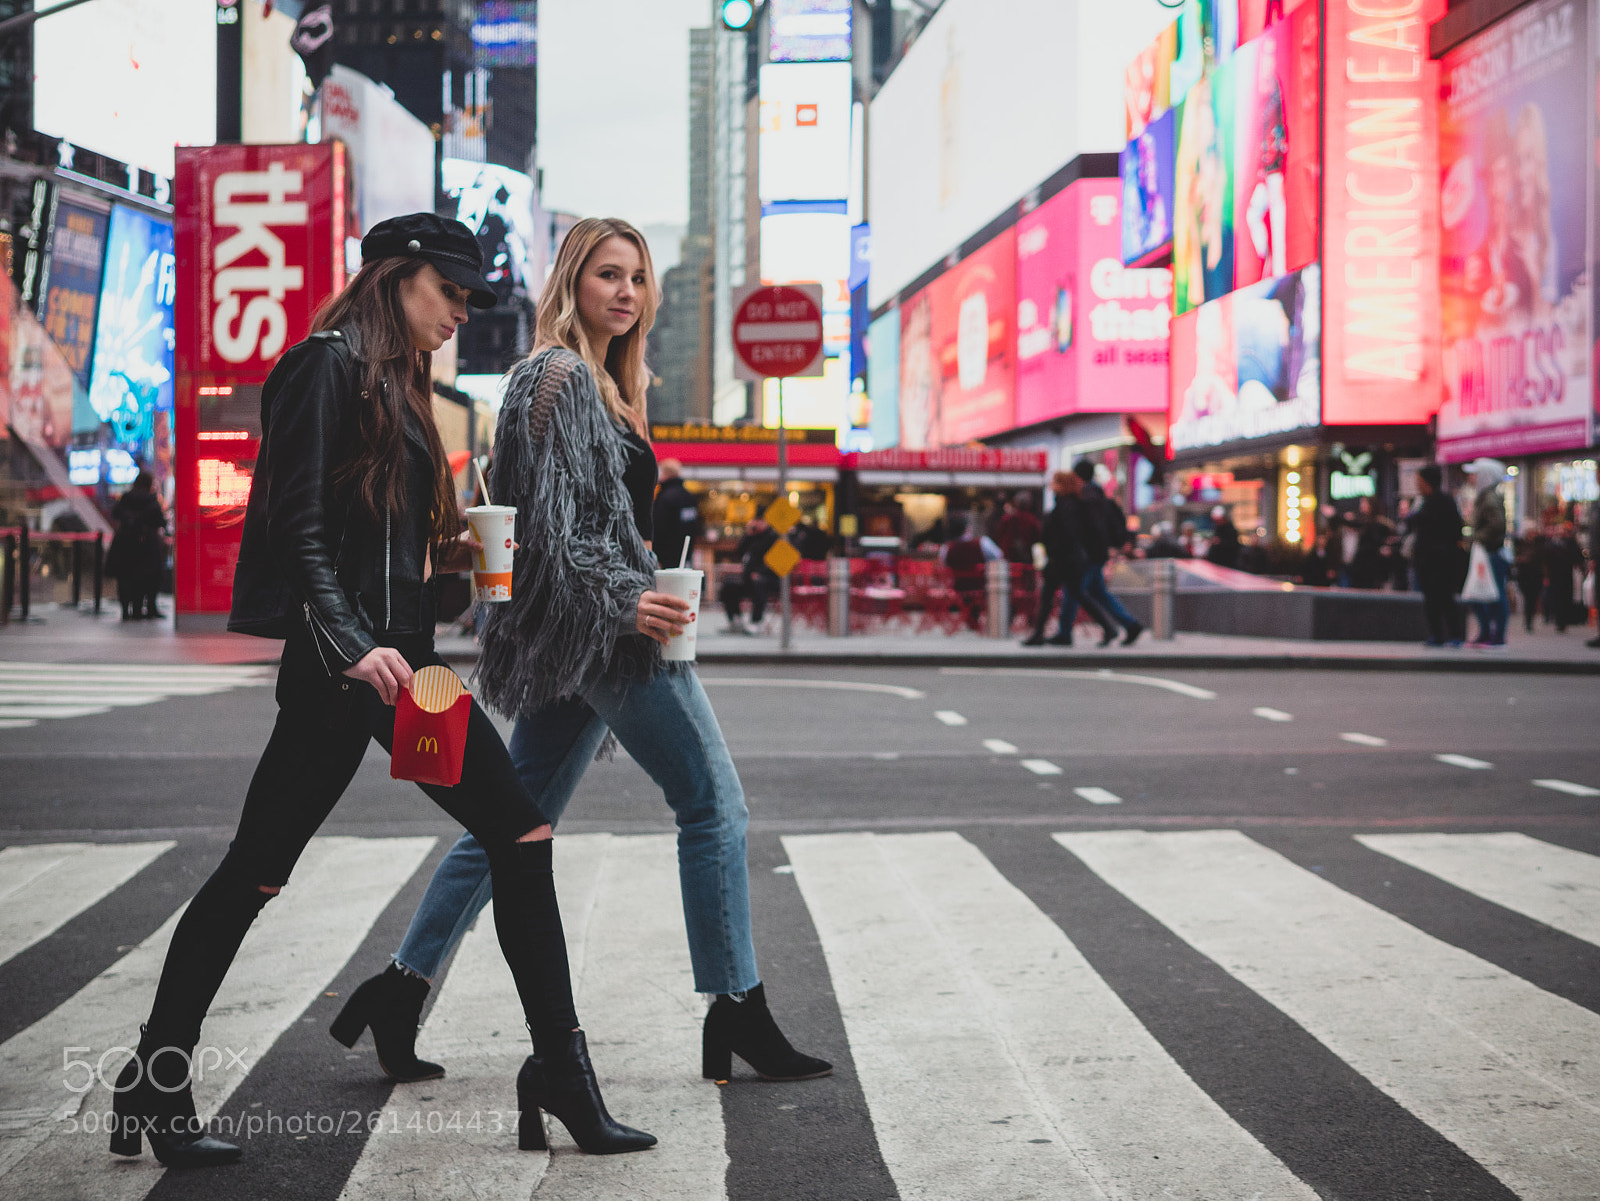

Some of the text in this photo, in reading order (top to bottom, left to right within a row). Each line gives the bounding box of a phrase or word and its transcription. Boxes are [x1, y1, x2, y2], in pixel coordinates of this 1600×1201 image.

[213, 161, 309, 364] tkts
[1344, 98, 1423, 382] AMERICAN
[746, 300, 808, 320] DO NOT
[751, 343, 806, 362] ENTER
